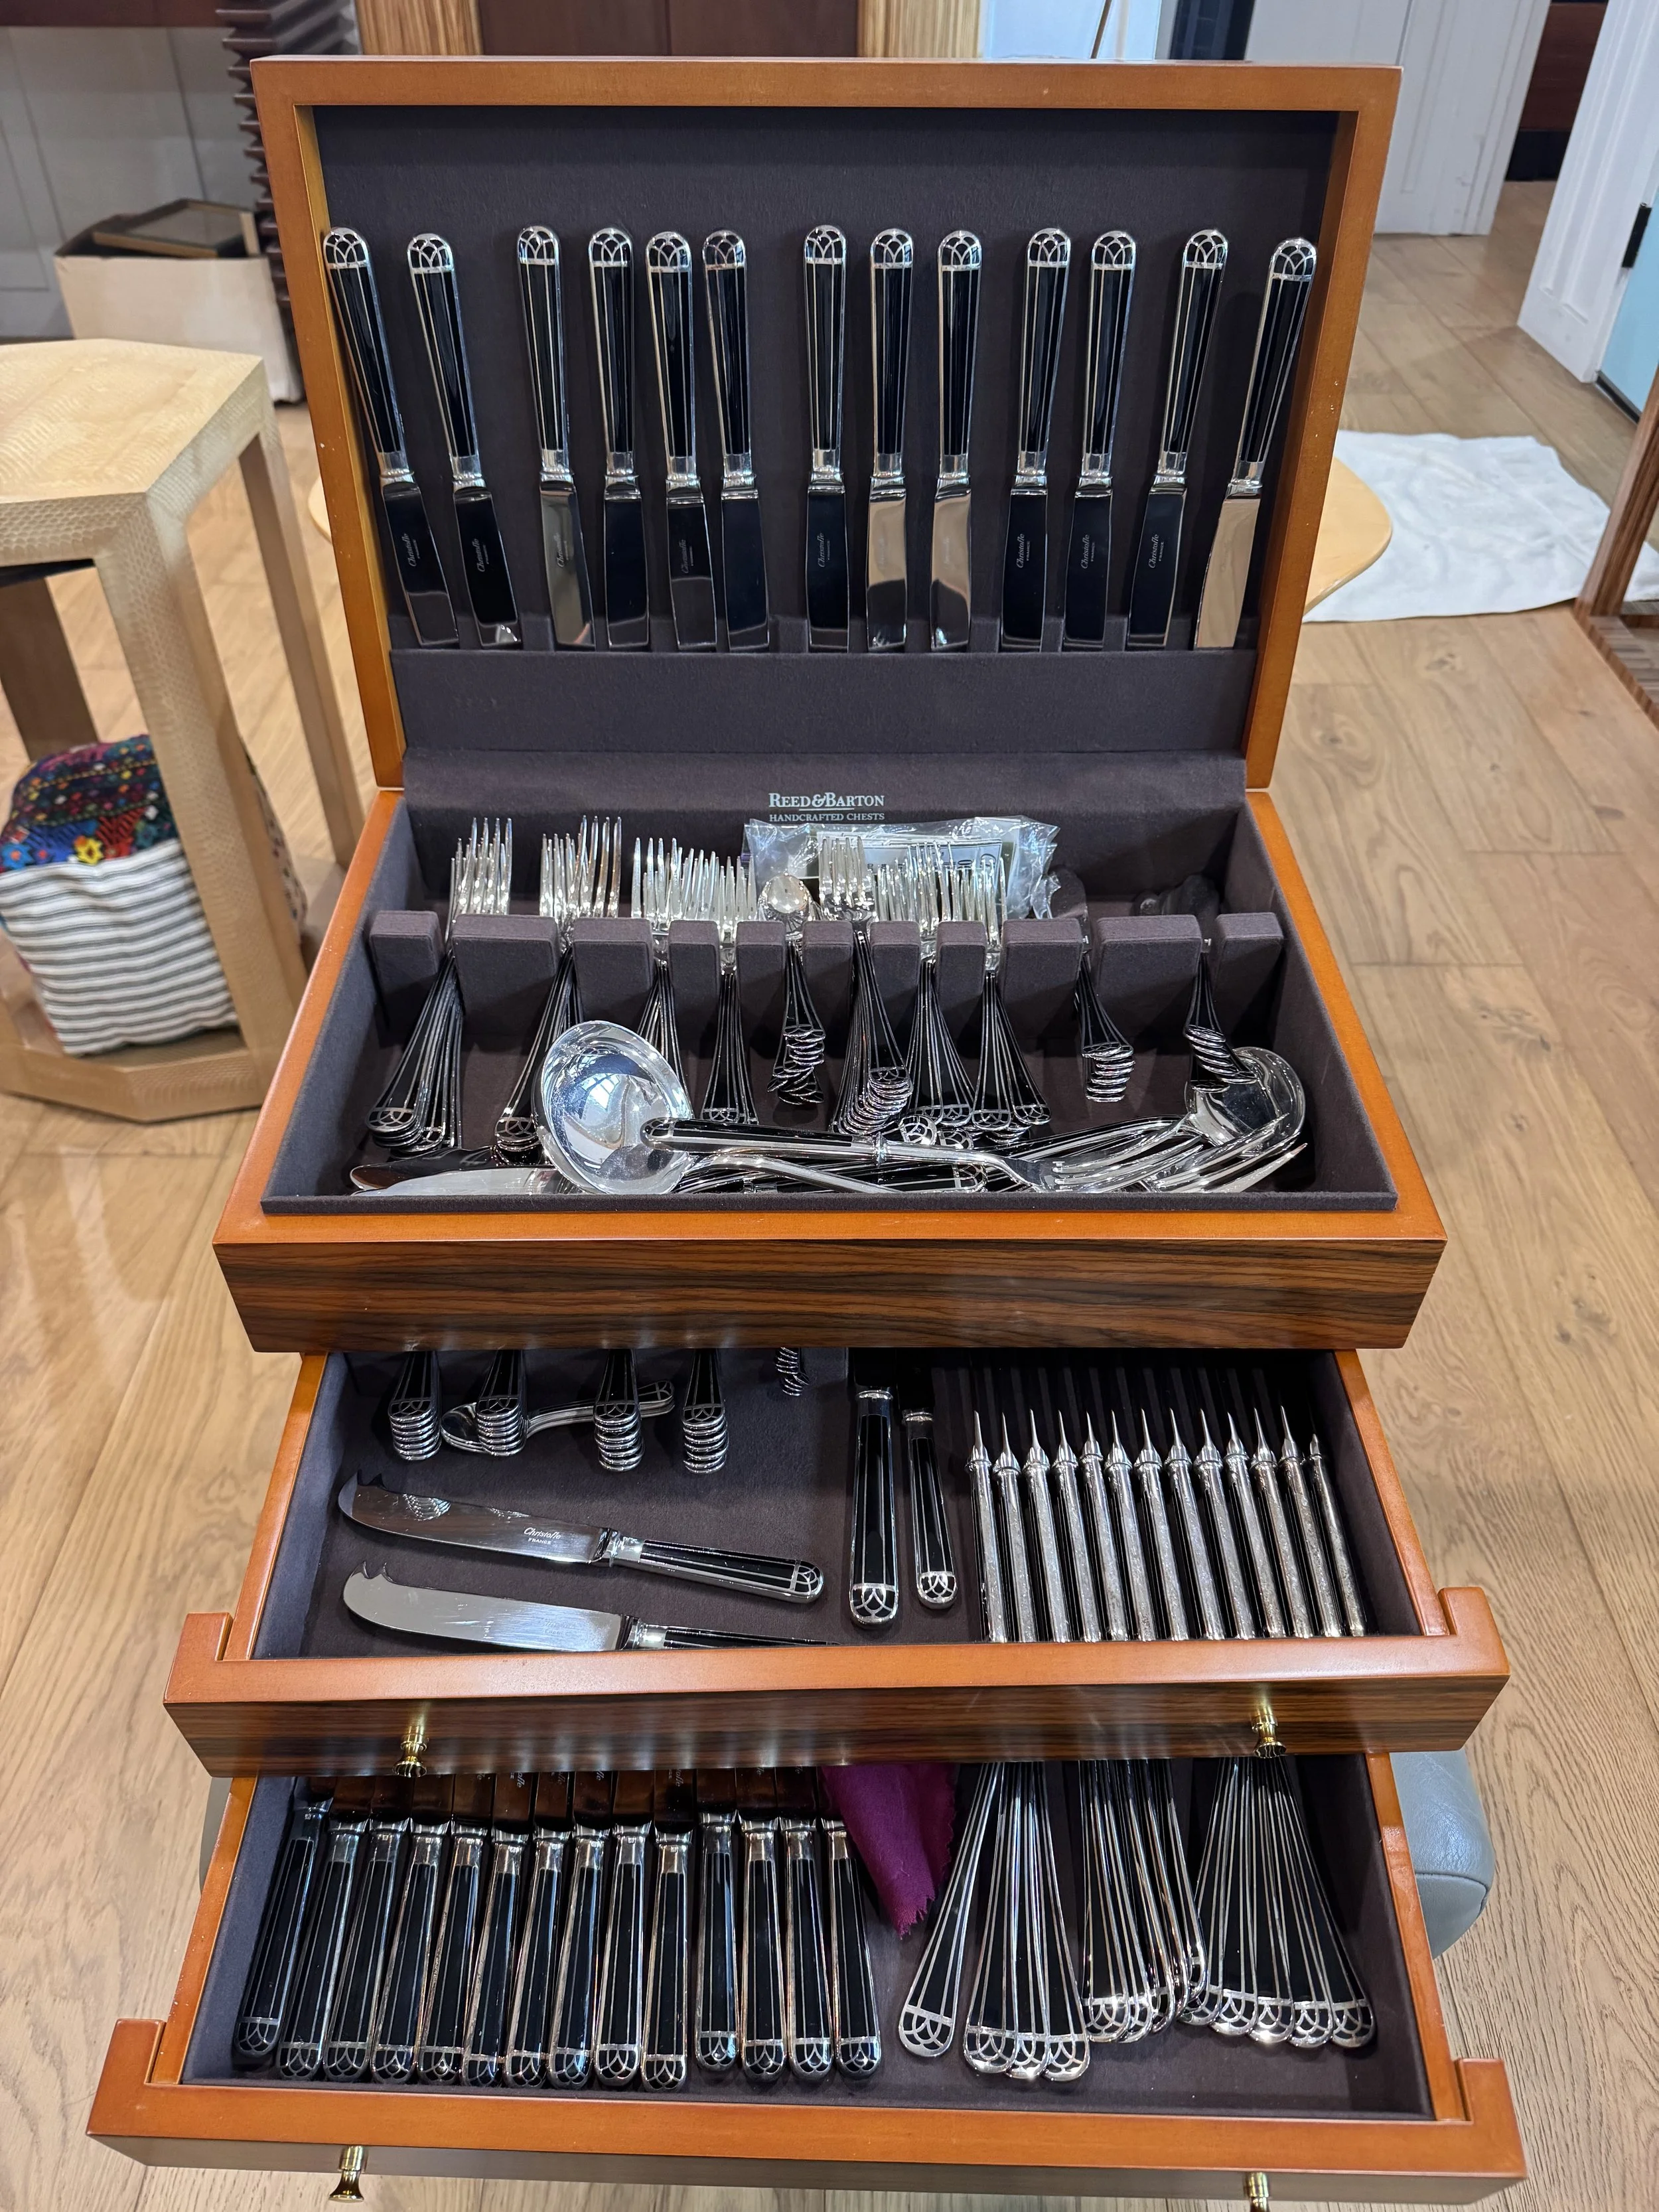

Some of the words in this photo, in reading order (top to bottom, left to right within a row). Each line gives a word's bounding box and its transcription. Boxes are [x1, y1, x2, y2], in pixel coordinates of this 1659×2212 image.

[1016, 534, 1025, 568] Christofle
[1080, 534, 1090, 569] Christofle
[1148, 534, 1159, 568] Christofle
[770, 813, 844, 822] HANDCRAFTED
[524, 1527, 561, 1540] Christofle
